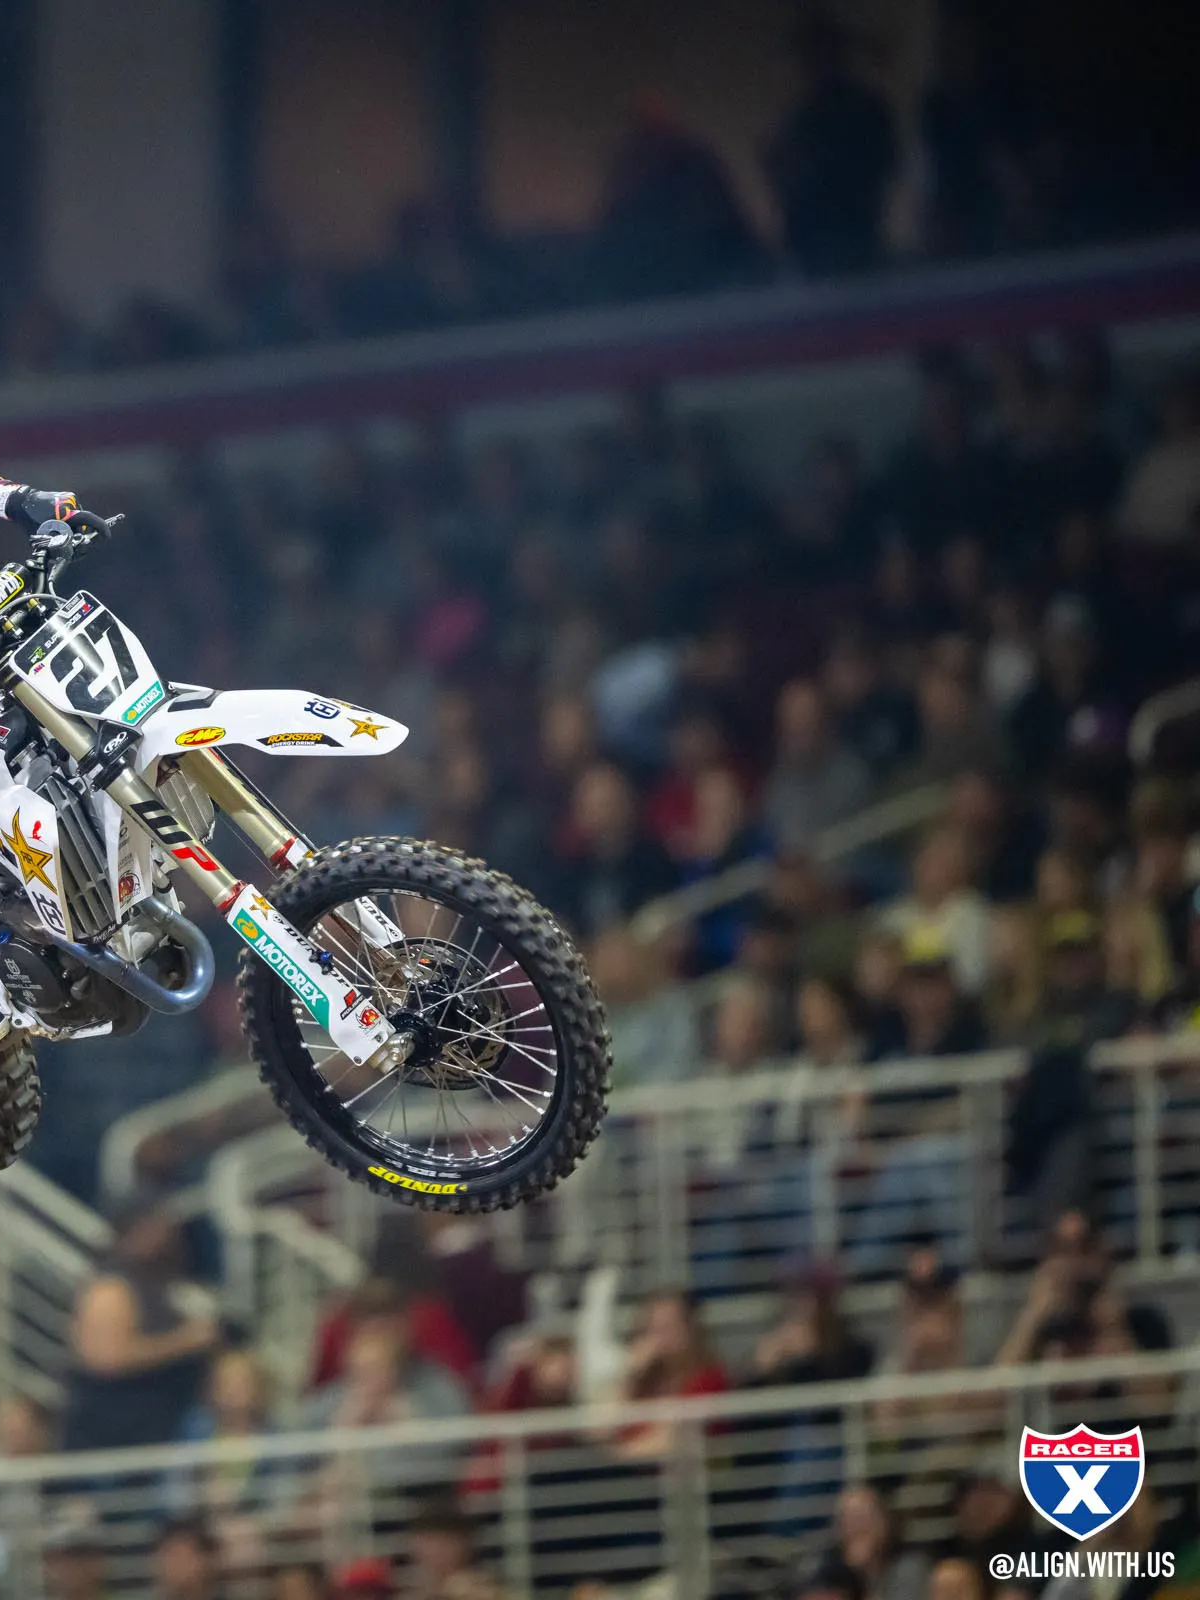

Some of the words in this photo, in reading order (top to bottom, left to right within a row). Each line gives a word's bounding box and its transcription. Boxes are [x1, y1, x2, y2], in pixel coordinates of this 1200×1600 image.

[50, 609, 139, 715] 27
[177, 727, 226, 746] FMF
[267, 732, 323, 745] ROCKSTAR
[255, 935, 325, 1008] MOTOREX
[284, 926, 350, 989] DUNOP
[367, 1164, 461, 1195] DUNLOP
